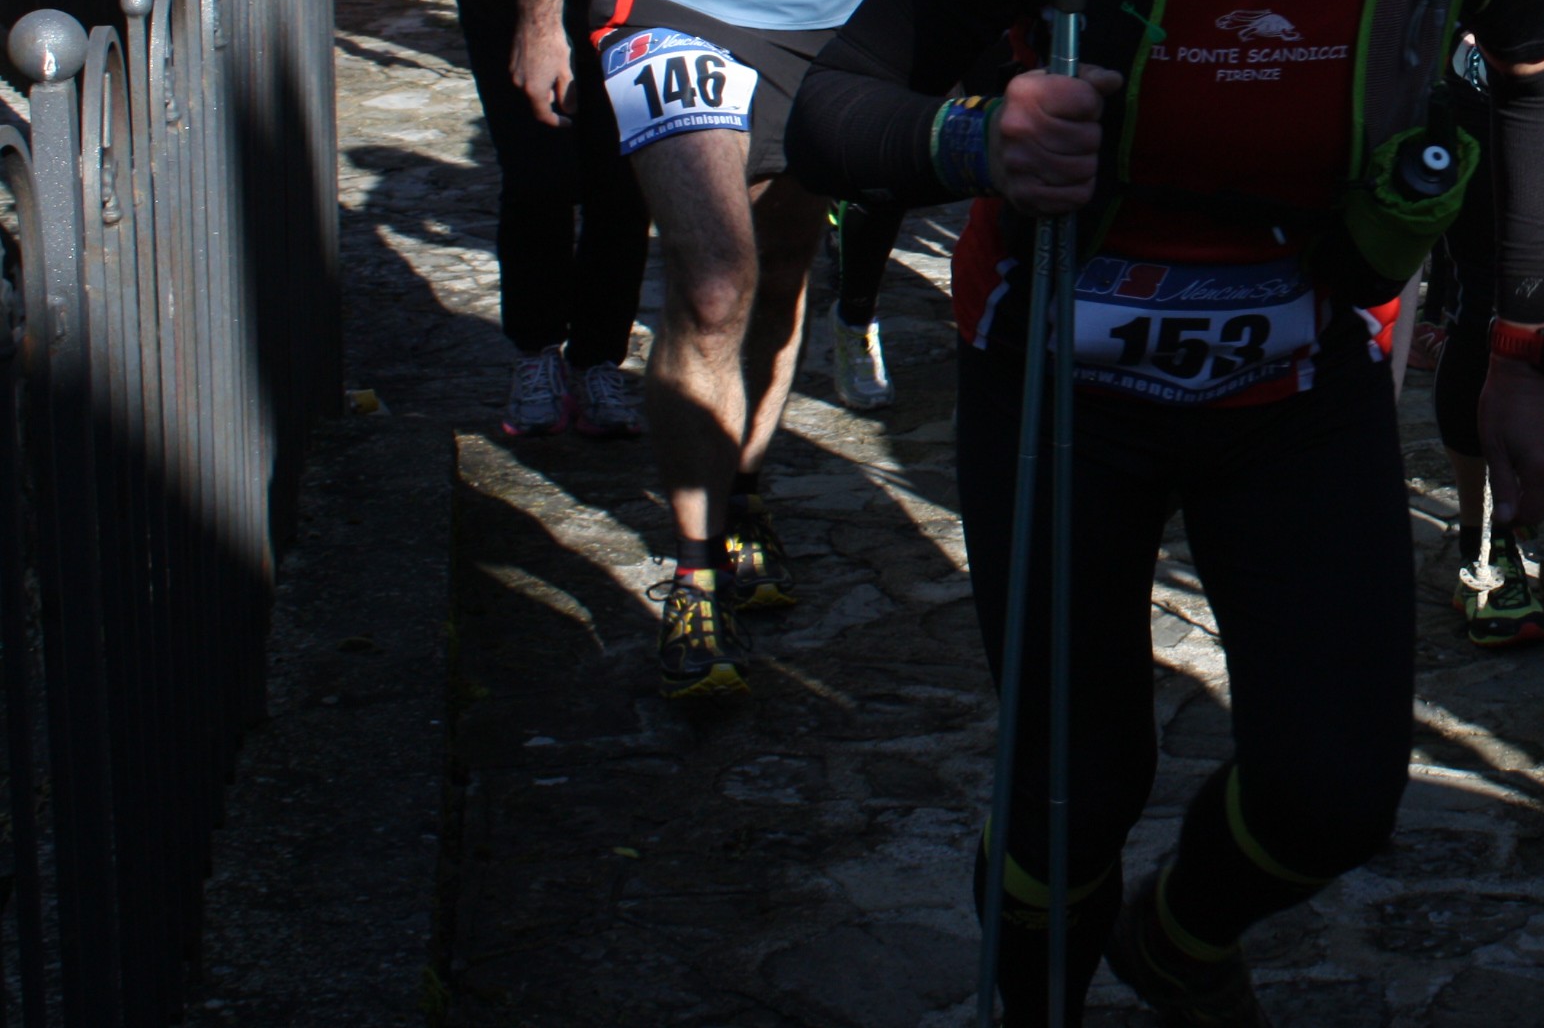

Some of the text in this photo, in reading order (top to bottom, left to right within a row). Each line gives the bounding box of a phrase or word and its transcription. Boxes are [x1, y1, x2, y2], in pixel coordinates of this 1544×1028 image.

[1152, 45, 1349, 63] IL PONTE SCANDICCI
[633, 54, 726, 120] 146
[1216, 69, 1282, 82] FIRENZE
[629, 114, 742, 148] www.nencinisport.it
[1110, 314, 1270, 379] 153
